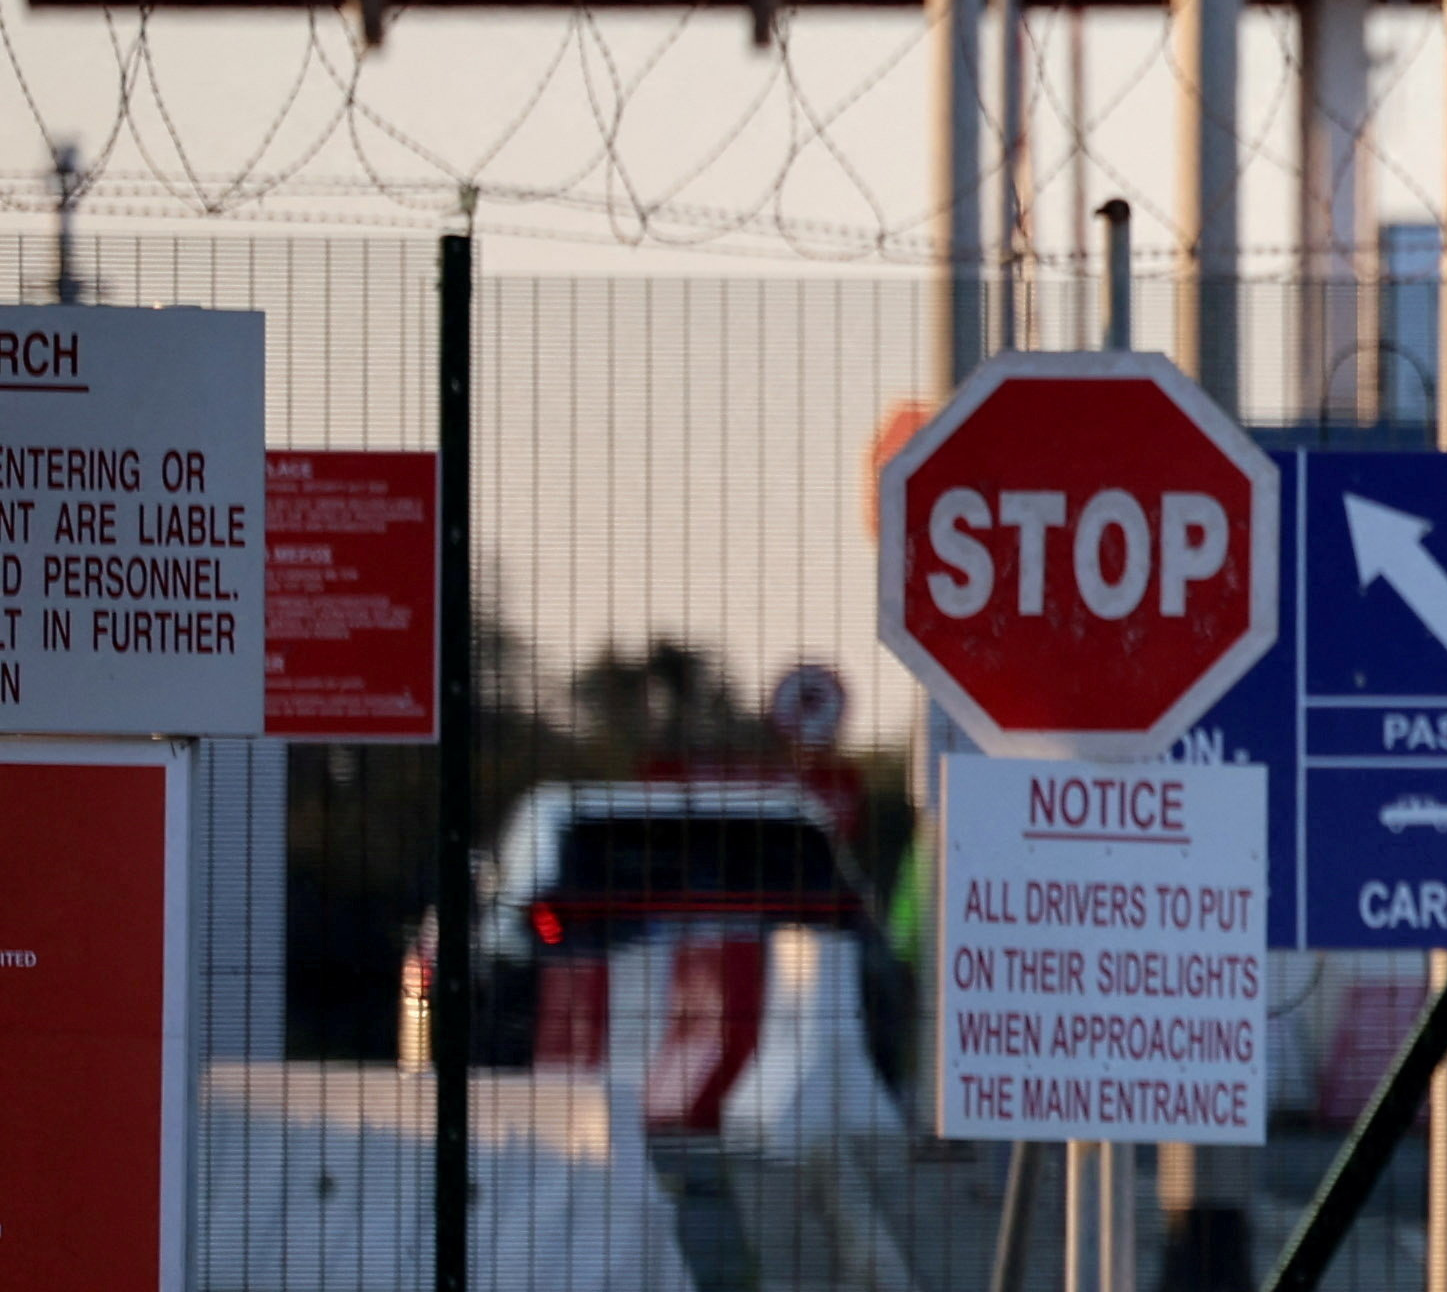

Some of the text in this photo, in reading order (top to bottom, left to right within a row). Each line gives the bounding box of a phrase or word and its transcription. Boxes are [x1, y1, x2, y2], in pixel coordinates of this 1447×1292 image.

[0, 447, 205, 494] NTERING OR
[55, 502, 117, 545] ARE
[139, 504, 246, 548] LIABLE
[2, 554, 22, 597] D
[44, 556, 239, 601] PERSONNEL.
[926, 486, 1230, 621] STOP
[43, 609, 70, 651] IN
[93, 611, 236, 655] FURTHER
[1165, 726, 1224, 766] ON
[1029, 777, 1186, 831] NOTICE
[964, 879, 1253, 933] ALL DRIVERS TO PUT
[954, 946, 1259, 1000] ON THEIR SIDELIGHTS
[957, 1012, 1254, 1064] WHEN APPROACHING
[960, 1075, 1248, 1129] THE MAIN ENTRANCE
